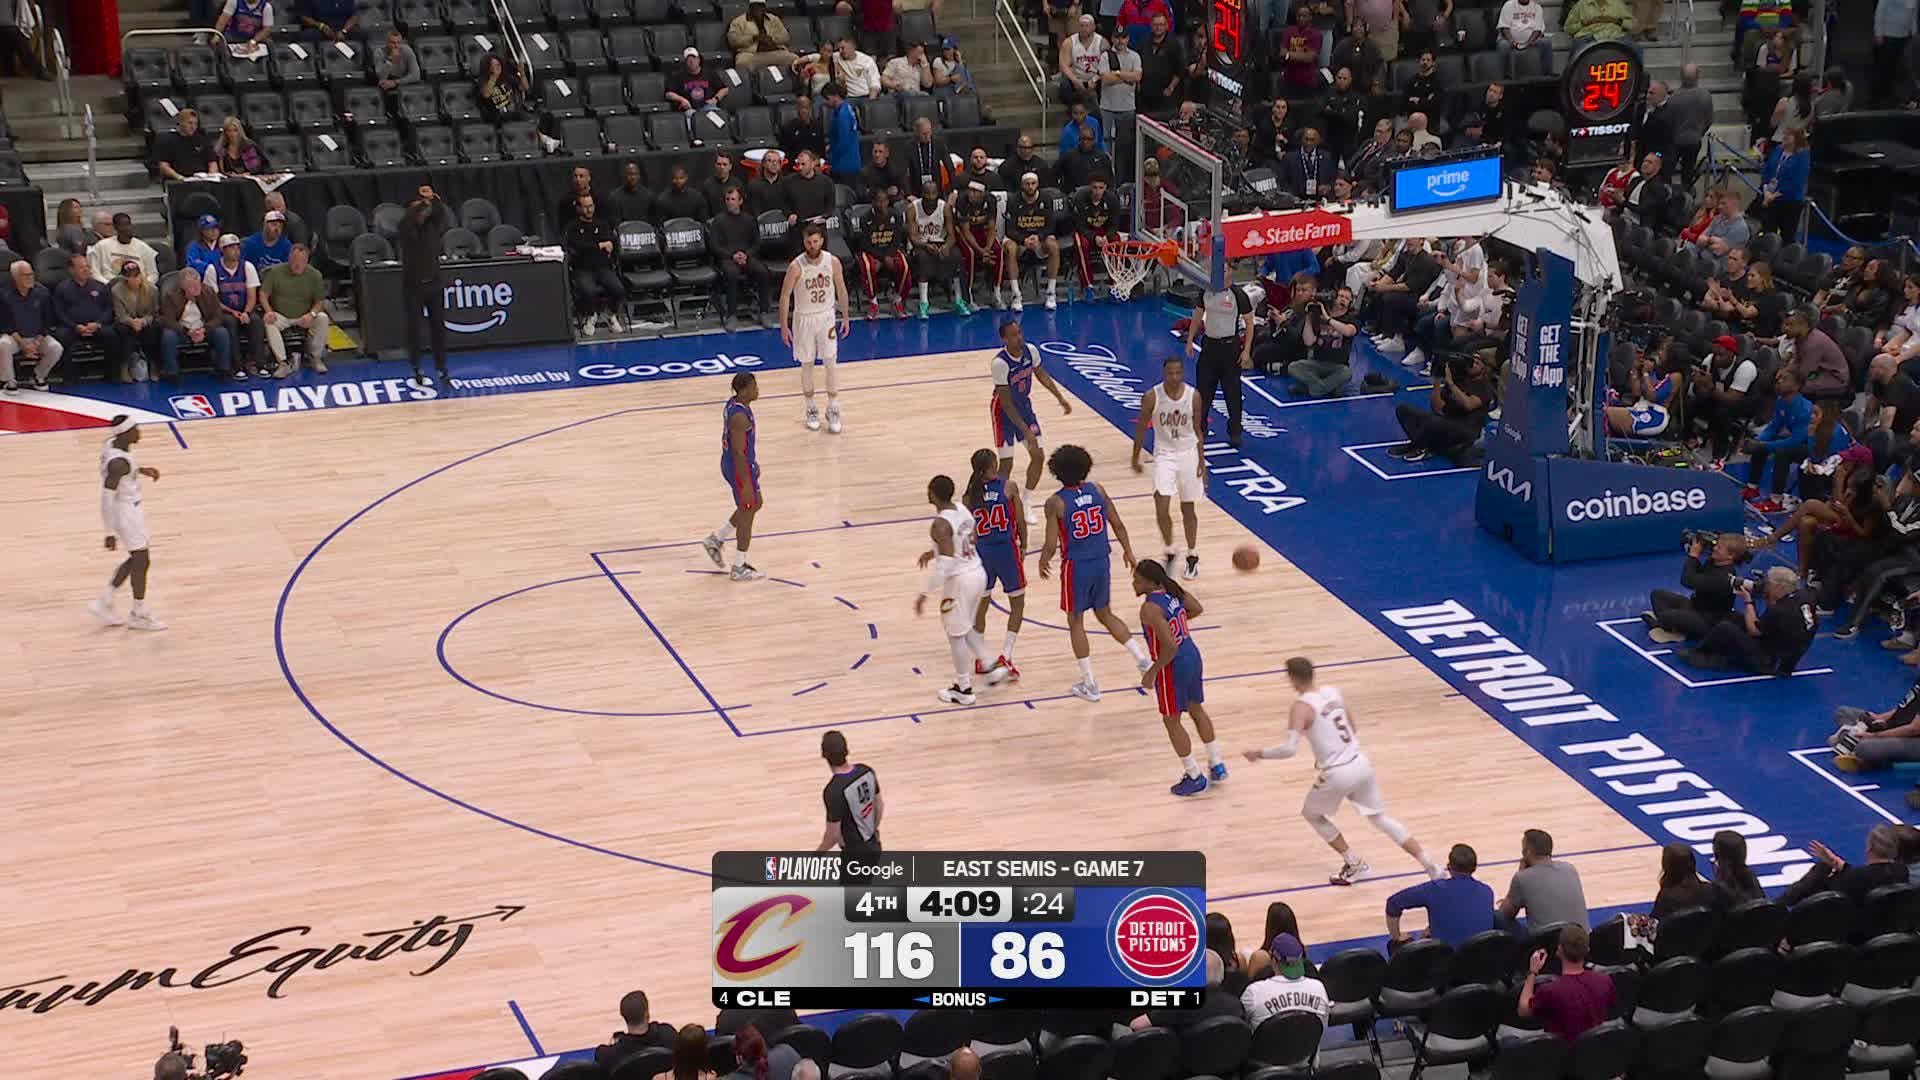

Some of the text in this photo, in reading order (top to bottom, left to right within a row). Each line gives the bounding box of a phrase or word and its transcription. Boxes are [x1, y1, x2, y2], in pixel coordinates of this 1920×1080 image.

[1590, 61, 1629, 82] 4:09
[1583, 83, 1621, 112] 24
[1587, 122, 1631, 136] TISSOT
[1427, 168, 1469, 188] prime
[443, 278, 513, 309] rime
[805, 274, 831, 290] CAVS
[811, 290, 826, 303] 32
[1540, 324, 1562, 345] GET
[1539, 344, 1560, 364] THE
[220, 353, 764, 417] PLAYOFFS Presented by Google
[1543, 364, 1564, 388] App
[1567, 486, 1706, 522] coinbase
[974, 503, 1009, 537] 24
[1072, 505, 1104, 540] 35
[1168, 607, 1190, 645] 20
[1380, 599, 1620, 727] DETROIT
[1333, 715, 1352, 743] 5
[1264, 991, 1321, 1014] PROFOUND
